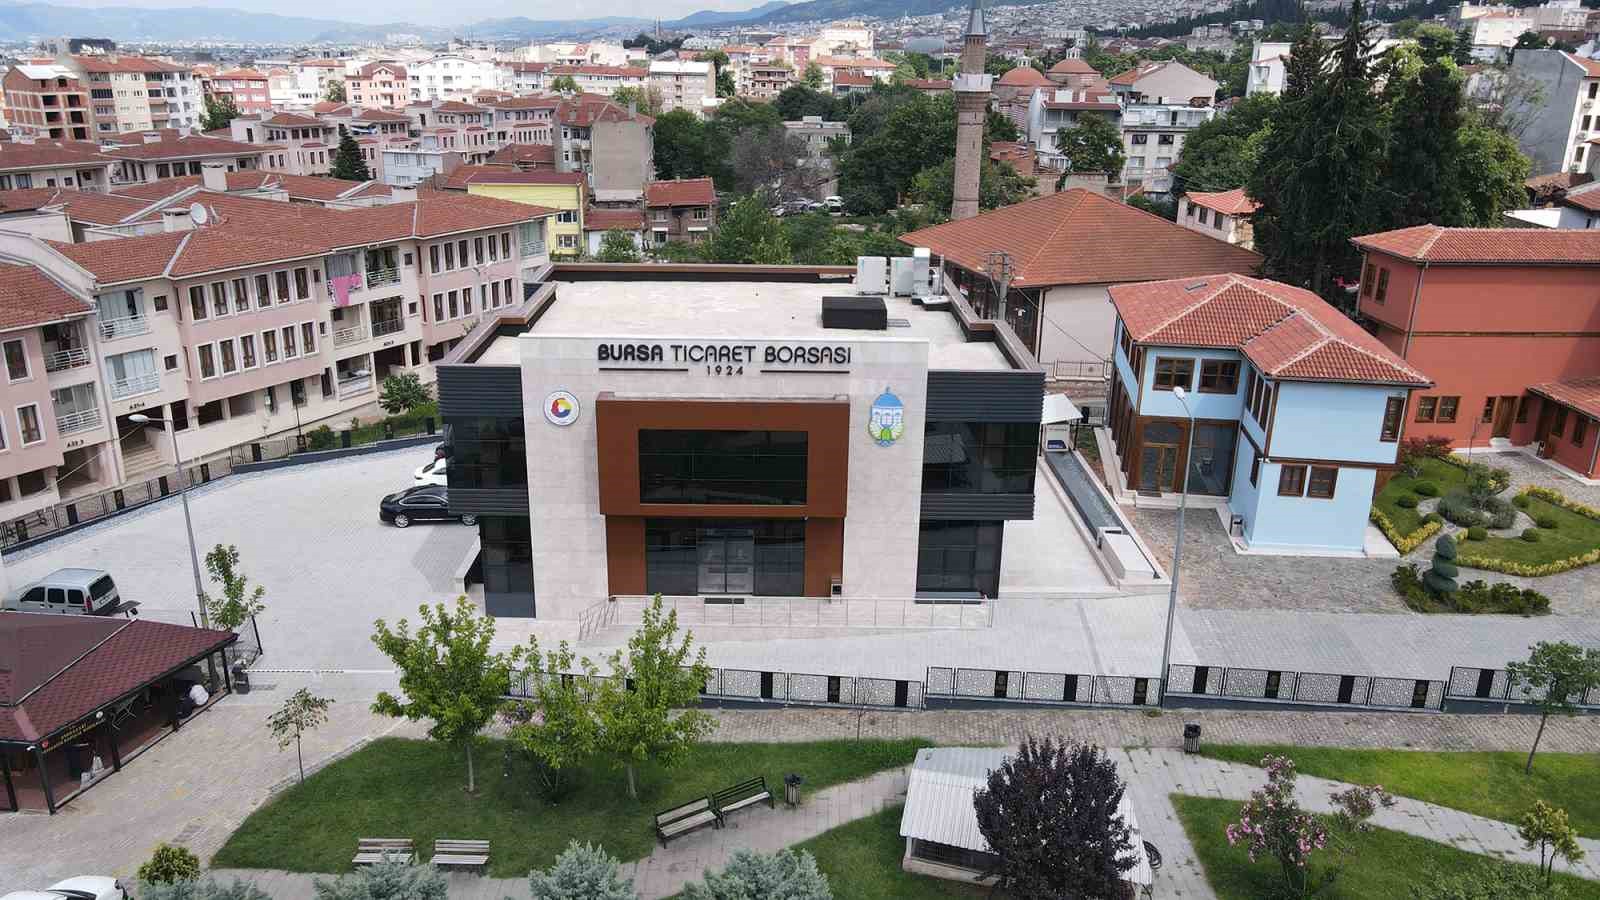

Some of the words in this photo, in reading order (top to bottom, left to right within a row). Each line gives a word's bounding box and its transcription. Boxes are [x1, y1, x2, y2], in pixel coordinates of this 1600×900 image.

[598, 344, 663, 361] BURSA
[765, 346, 851, 364] BORSASI
[707, 365, 744, 376] 1924
